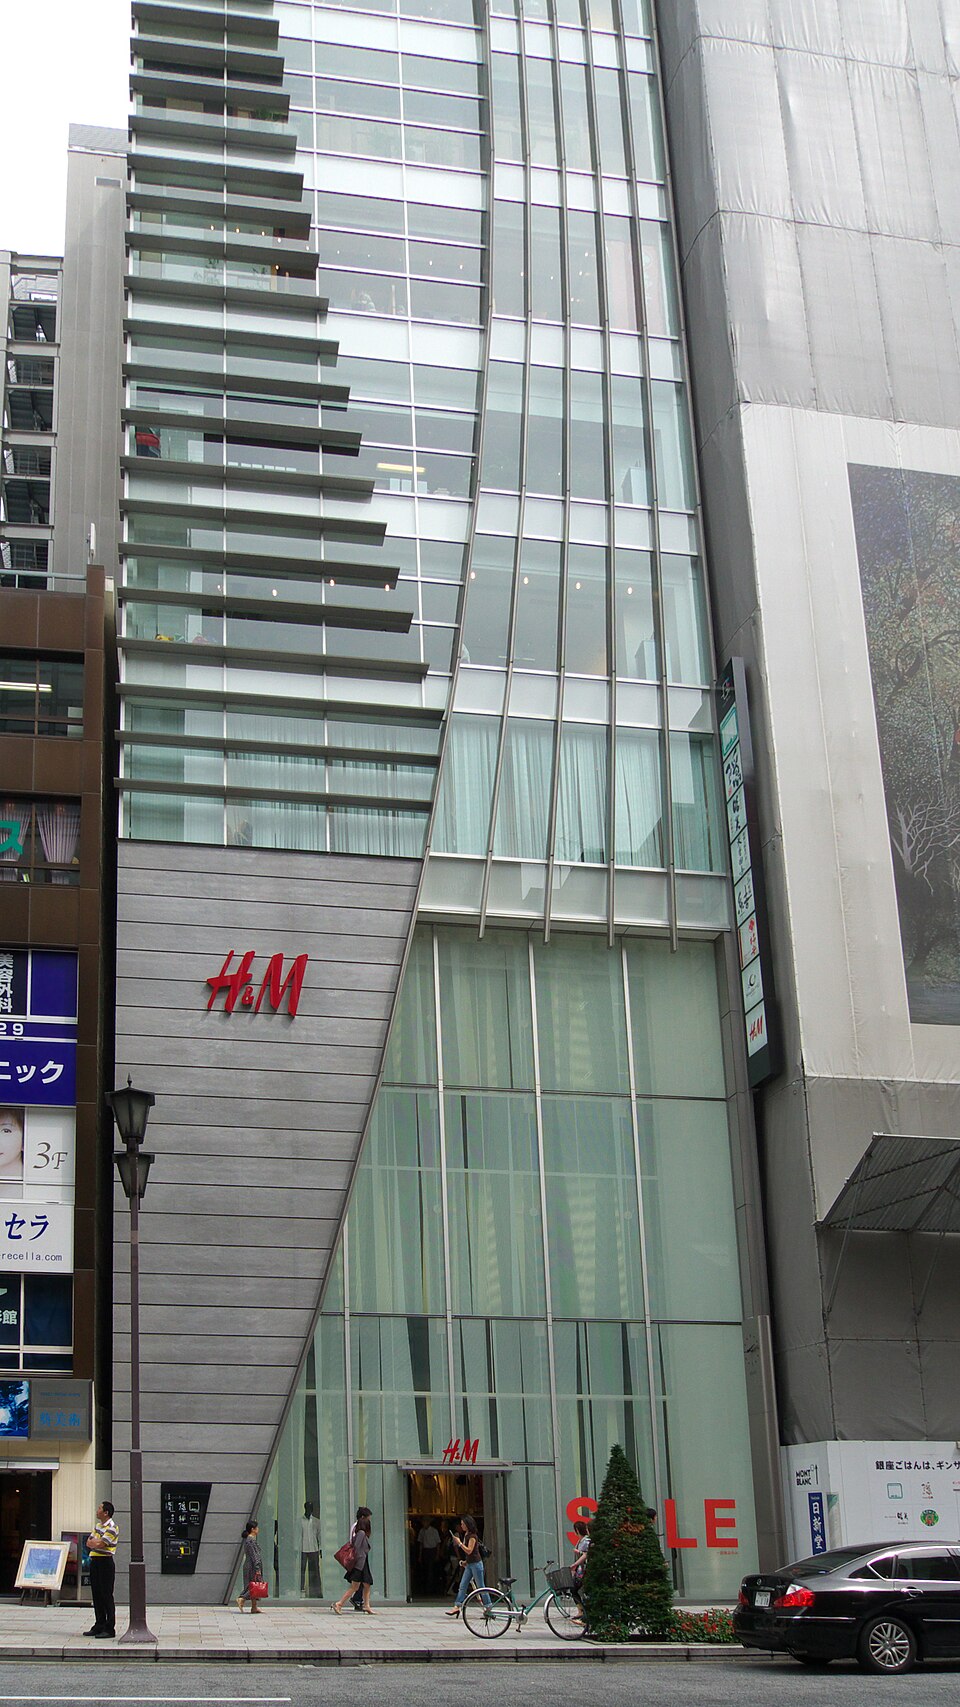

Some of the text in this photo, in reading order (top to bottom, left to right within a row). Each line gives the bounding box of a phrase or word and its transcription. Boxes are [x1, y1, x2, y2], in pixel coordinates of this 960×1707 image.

[207, 949, 308, 1016] H&M
[33, 1141, 68, 1169] 3F
[5, 1212, 49, 1241] セラ
[0, 1251, 63, 1262] recella.com
[0, 1310, 18, 1325] 館
[442, 1438, 480, 1465] H&M
[796, 1469, 811, 1478] MONT
[796, 1477, 812, 1486] BLANC
[565, 1497, 739, 1549] SLE
